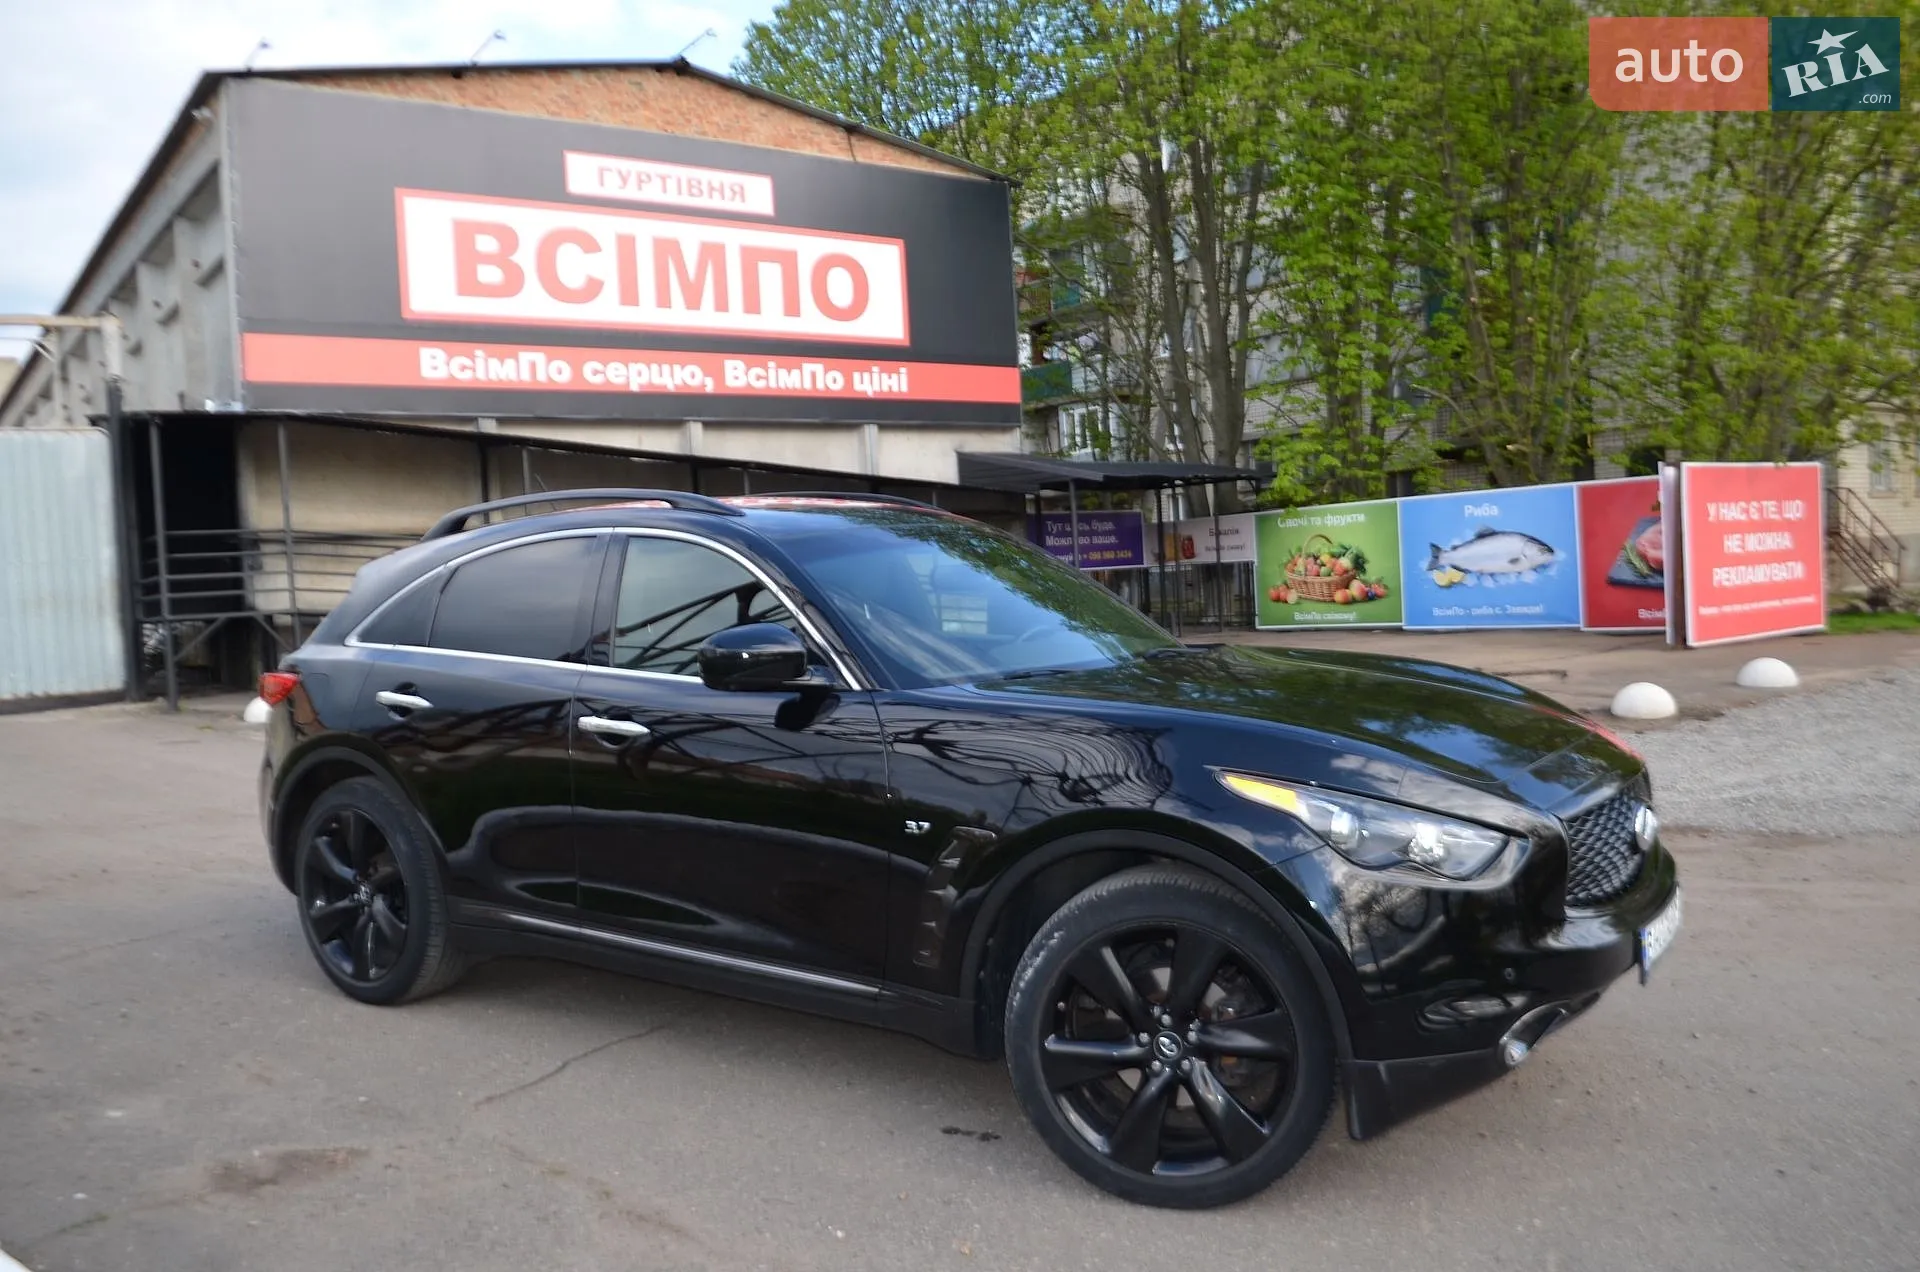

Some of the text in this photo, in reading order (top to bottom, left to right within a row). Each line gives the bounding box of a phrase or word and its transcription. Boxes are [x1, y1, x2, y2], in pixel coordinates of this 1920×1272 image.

[597, 164, 747, 204] ГУРТІВНЯ
[451, 217, 871, 322] ВСІМПО
[418, 346, 909, 399] ВсімПо серцю, ВсімПо ціні
[1324, 513, 1366, 527] фрукти
[1464, 503, 1499, 517] Риба
[1706, 502, 1717, 523] У
[1718, 500, 1748, 521] НАС
[1782, 498, 1806, 521] ЩО
[1046, 535, 1090, 546] Можлво
[1723, 530, 1793, 554] НЕ МОЖНА
[1712, 560, 1804, 588] РЕКЛАМУВАТИ
